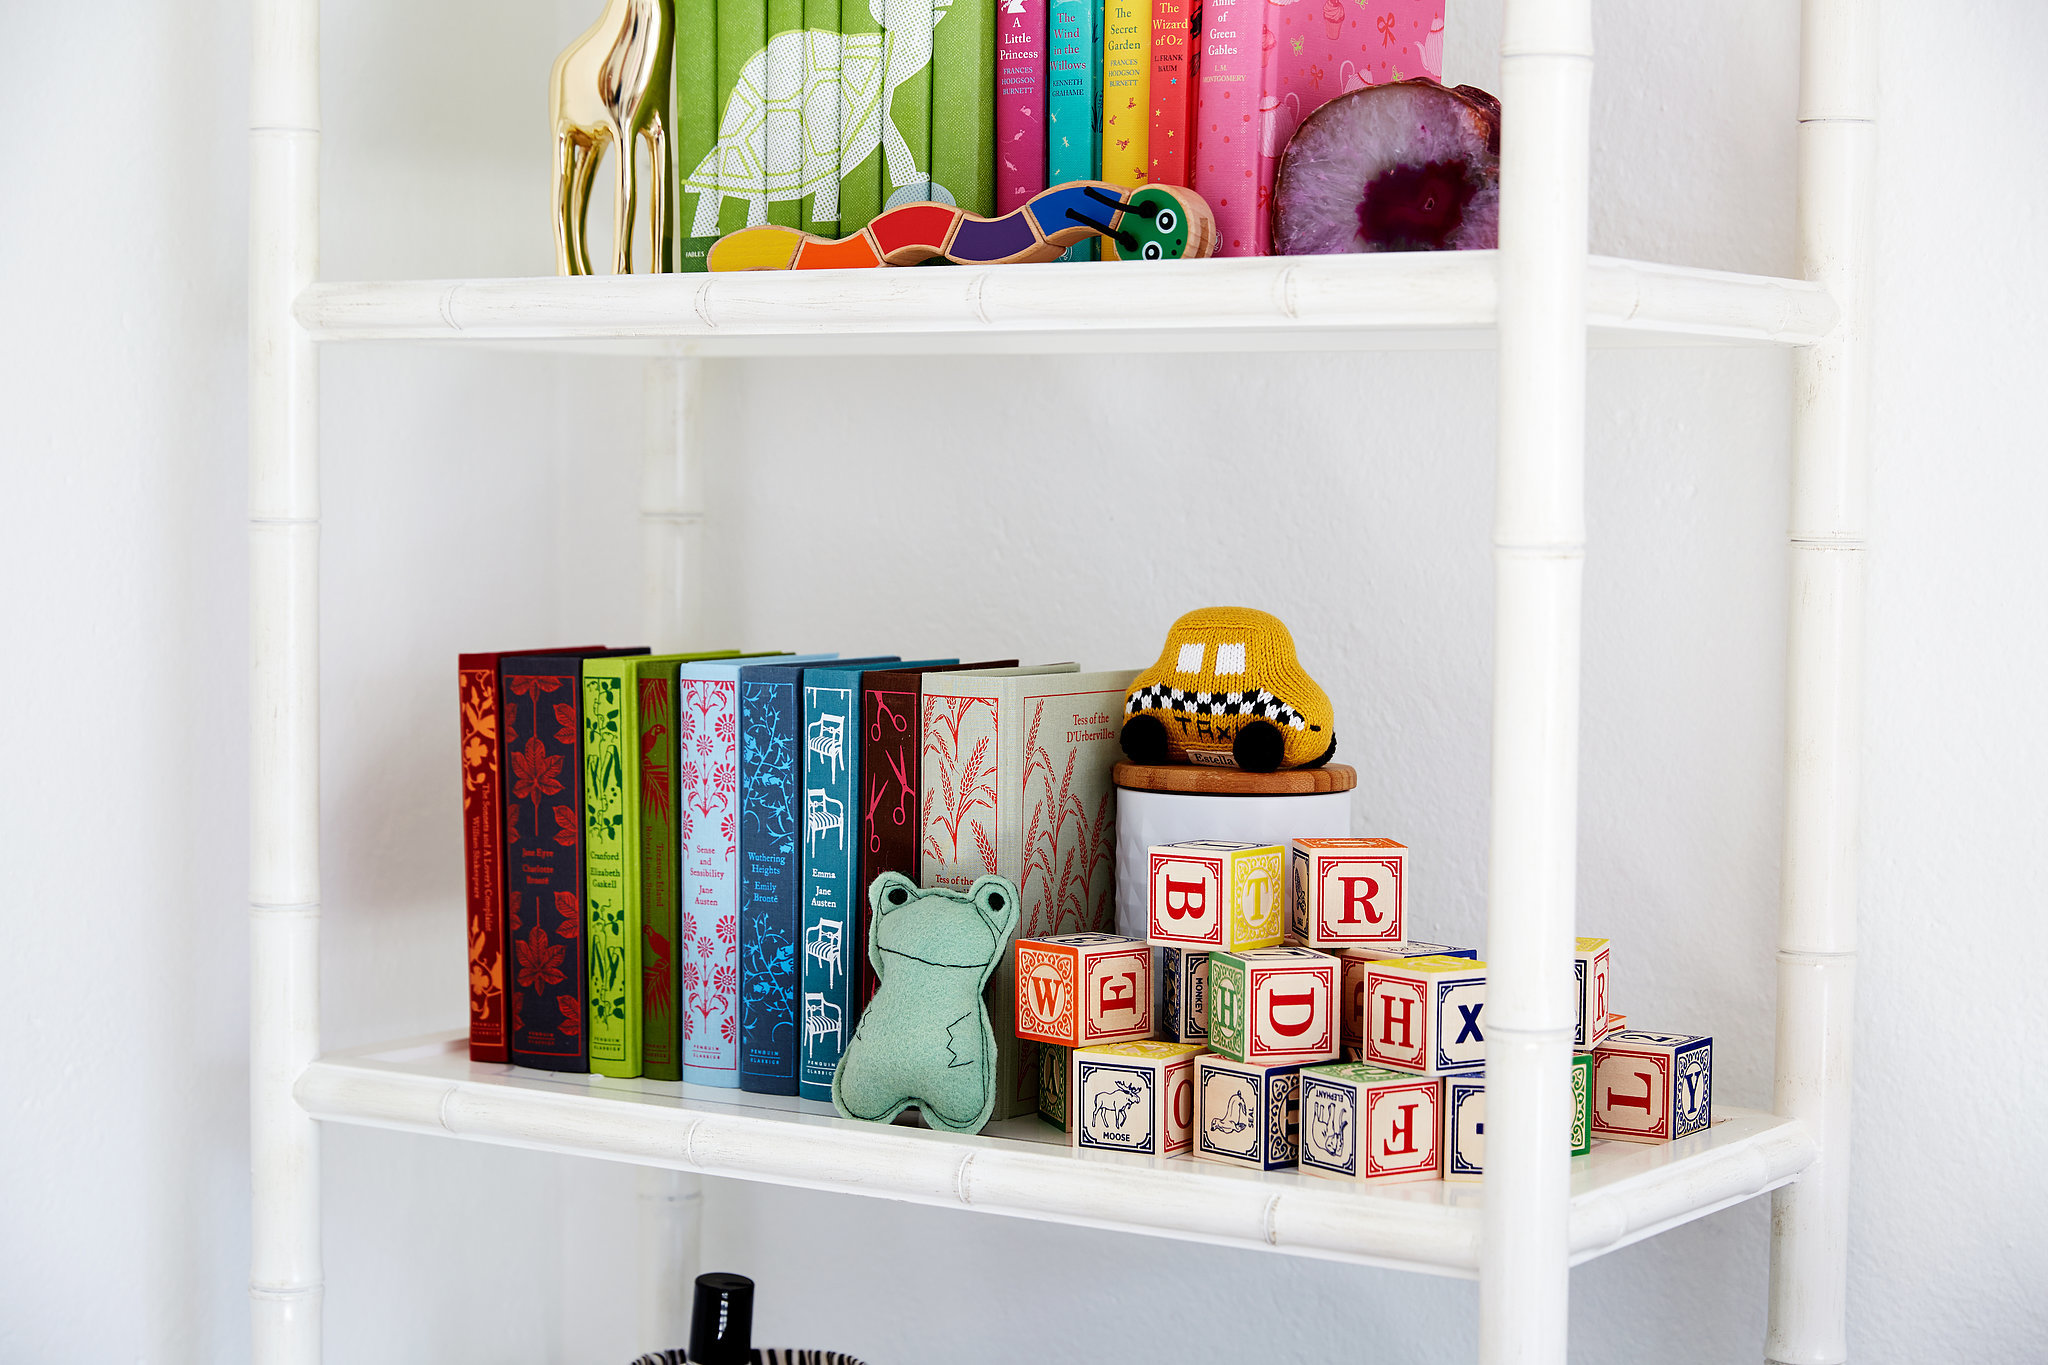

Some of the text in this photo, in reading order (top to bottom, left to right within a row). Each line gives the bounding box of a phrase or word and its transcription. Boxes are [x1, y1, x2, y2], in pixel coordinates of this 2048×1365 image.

[1115, 7, 1132, 18] The
[1160, 2, 1179, 13] The
[1012, 17, 1021, 28] A
[1057, 12, 1076, 23] The
[1217, 11, 1229, 23] of
[1110, 24, 1138, 35] Secret
[1152, 19, 1188, 30] Wizard
[1005, 32, 1032, 44] Little
[1054, 27, 1080, 39] Wind
[1210, 28, 1236, 39] Green
[1108, 39, 1141, 51] Garden
[1155, 34, 1183, 46] of Oz
[1000, 49, 1039, 60] Princess
[1054, 44, 1080, 55] in the
[1208, 44, 1238, 56] Gables
[1110, 58, 1138, 67] FRANCES
[1160, 54, 1183, 62] FRANK
[1003, 66, 1033, 75] FRANCES
[1050, 60, 1087, 71] Willows
[1109, 69, 1140, 78] HODGSON
[1001, 76, 1036, 85] HODGSON
[1052, 79, 1083, 87] KENNETH
[1109, 79, 1139, 87] BURNETT
[1002, 86, 1034, 95] BURNETT
[1051, 89, 1084, 97] GRAHAME
[1072, 713, 1110, 726] Tess of the
[1066, 730, 1115, 743] D'Urbervilles
[1194, 752, 1235, 766] Estella
[590, 851, 620, 861] Cranford
[697, 845, 716, 855] Sense
[700, 857, 712, 867] and
[747, 852, 786, 865] Wuthering
[590, 867, 621, 878] Elizabeth
[690, 867, 725, 881] Sensibility
[751, 864, 781, 877] Heights
[812, 868, 837, 879] Emma
[592, 879, 617, 889] Gaskell
[936, 874, 974, 886] Tess of the
[698, 884, 713, 896] Jane
[754, 881, 777, 894] Emily
[815, 885, 832, 897] Jane
[694, 897, 719, 907] Austen
[811, 898, 837, 908] Austen
[1165, 873, 1206, 921] B
[1246, 876, 1269, 921] T
[1337, 876, 1384, 924] R
[1030, 976, 1063, 1017] W
[1100, 972, 1137, 1019] E
[1195, 977, 1204, 1014] MONKEY
[1596, 972, 1606, 1022] R
[1219, 985, 1237, 1031] H
[1269, 987, 1315, 1037] D
[1380, 994, 1415, 1049] H
[1315, 1089, 1344, 1103] ELEPHANT
[1607, 1072, 1651, 1115] L
[1684, 1071, 1701, 1114] Y
[1103, 1131, 1130, 1142] MOOSE
[1383, 1104, 1420, 1157] F
